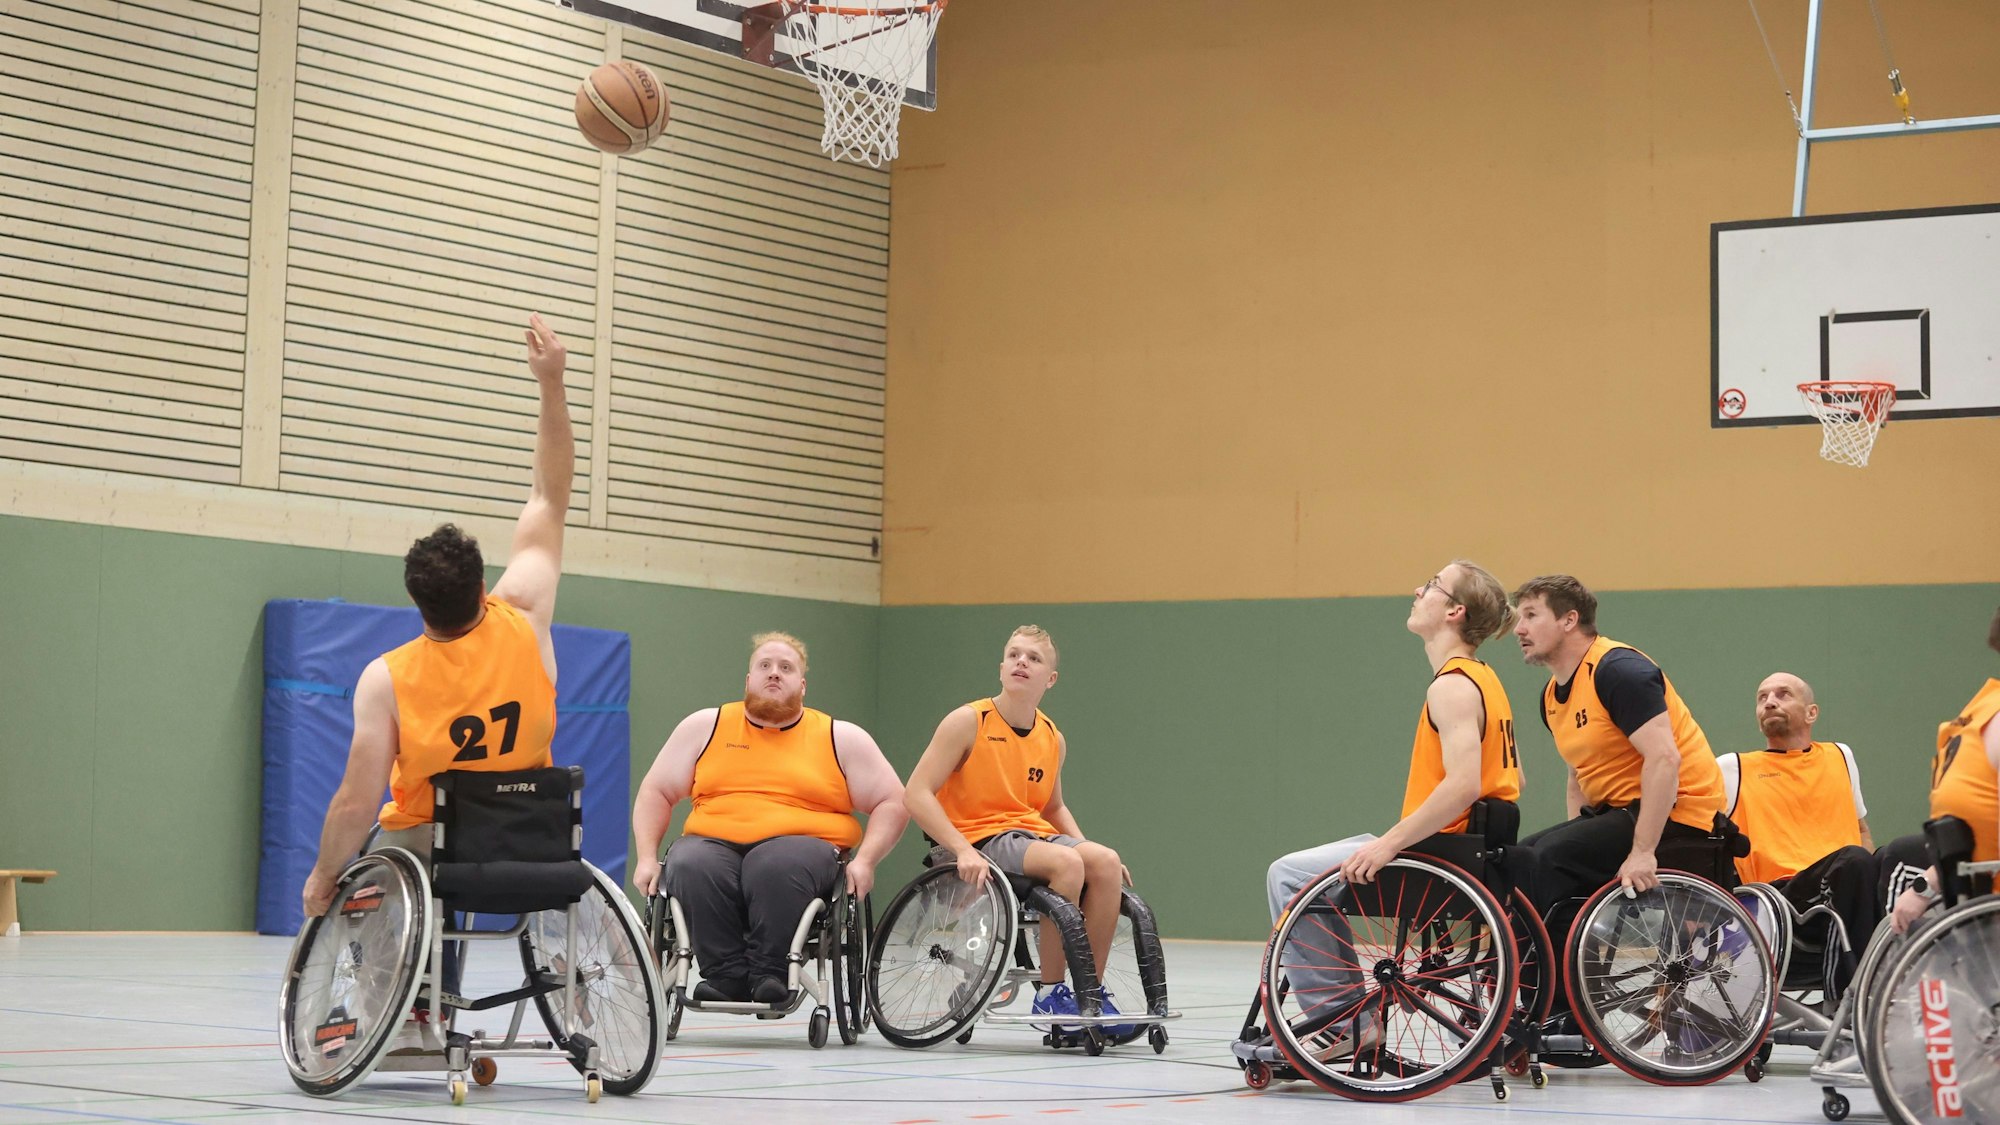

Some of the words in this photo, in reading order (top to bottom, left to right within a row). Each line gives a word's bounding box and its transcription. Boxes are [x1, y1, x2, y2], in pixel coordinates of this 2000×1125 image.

[1576, 708, 1588, 728] 25
[449, 701, 521, 762] 27
[1028, 767, 1043, 782] 29
[496, 782, 536, 792] MEYRA
[1923, 979, 1962, 1117] active
